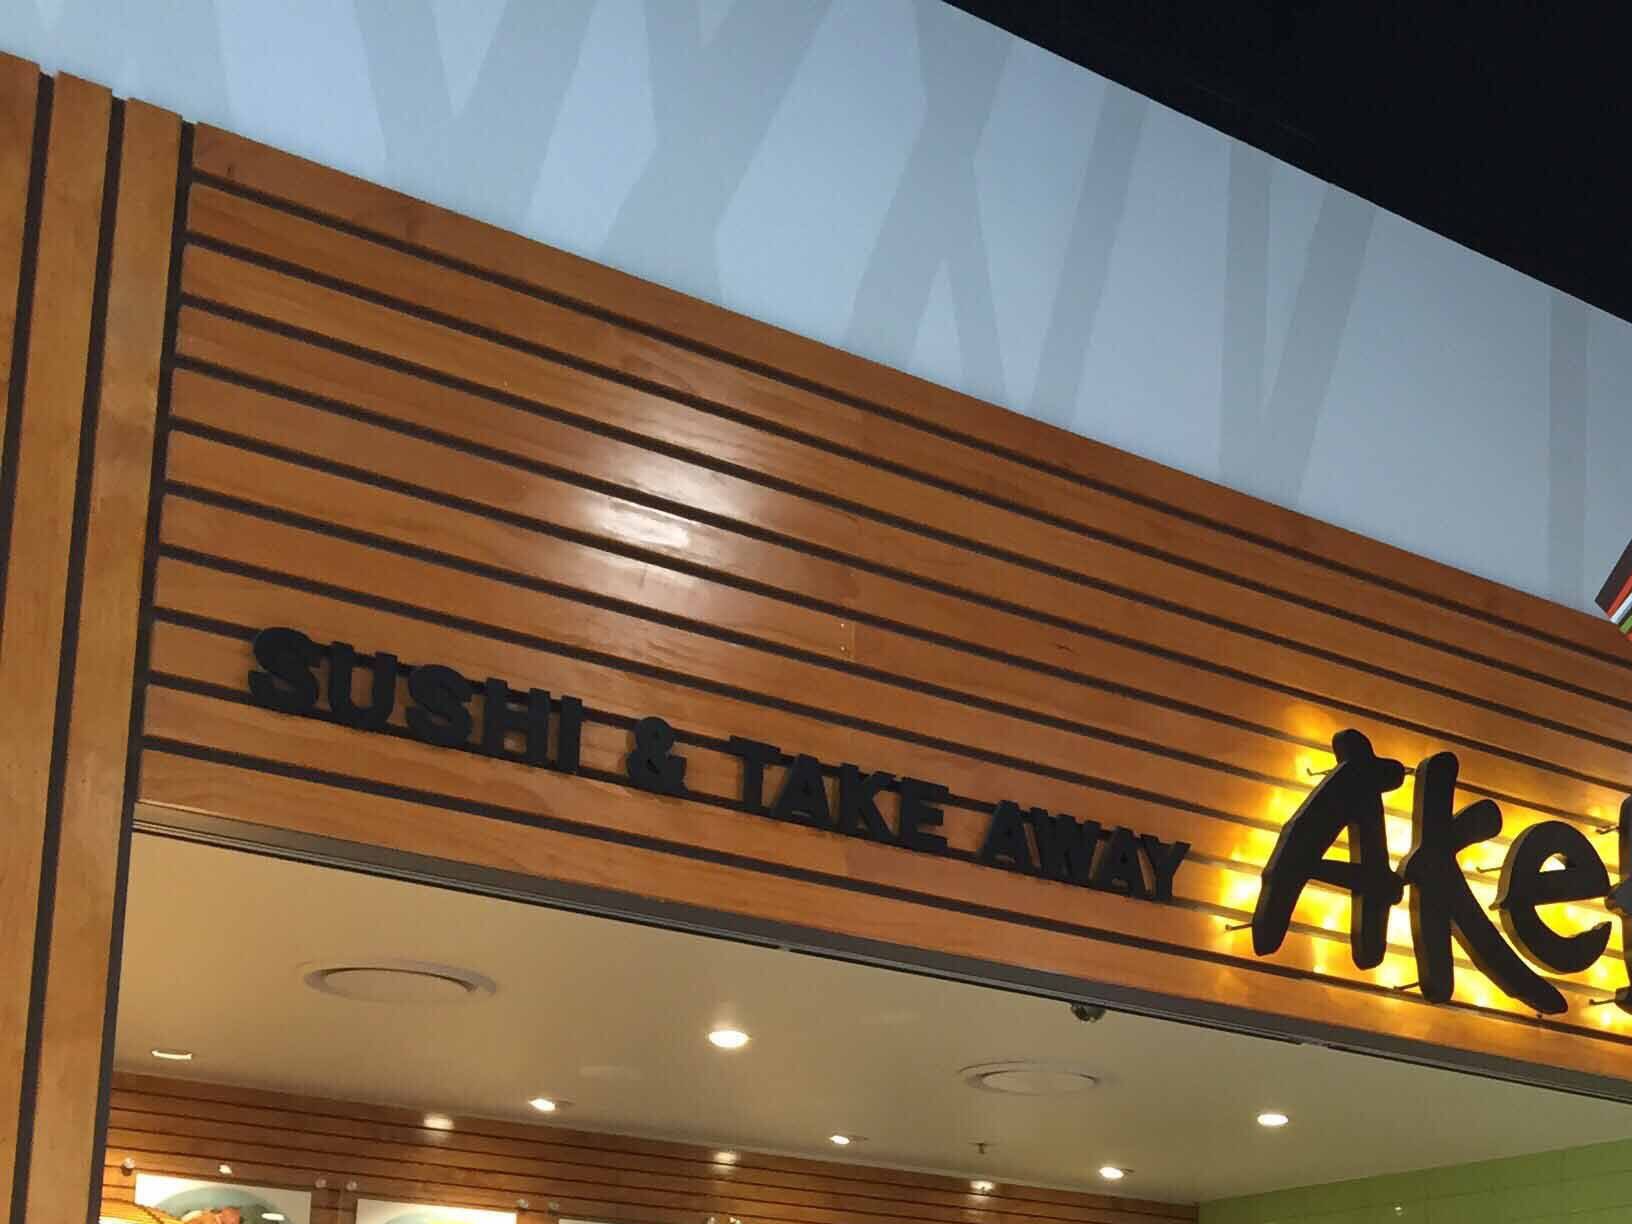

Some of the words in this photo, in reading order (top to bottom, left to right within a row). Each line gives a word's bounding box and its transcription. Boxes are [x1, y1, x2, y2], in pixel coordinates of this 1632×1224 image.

[246, 626, 586, 774] SUSHI
[622, 715, 688, 794] &
[728, 735, 950, 853] TAKE
[975, 799, 1191, 902] AWAY
